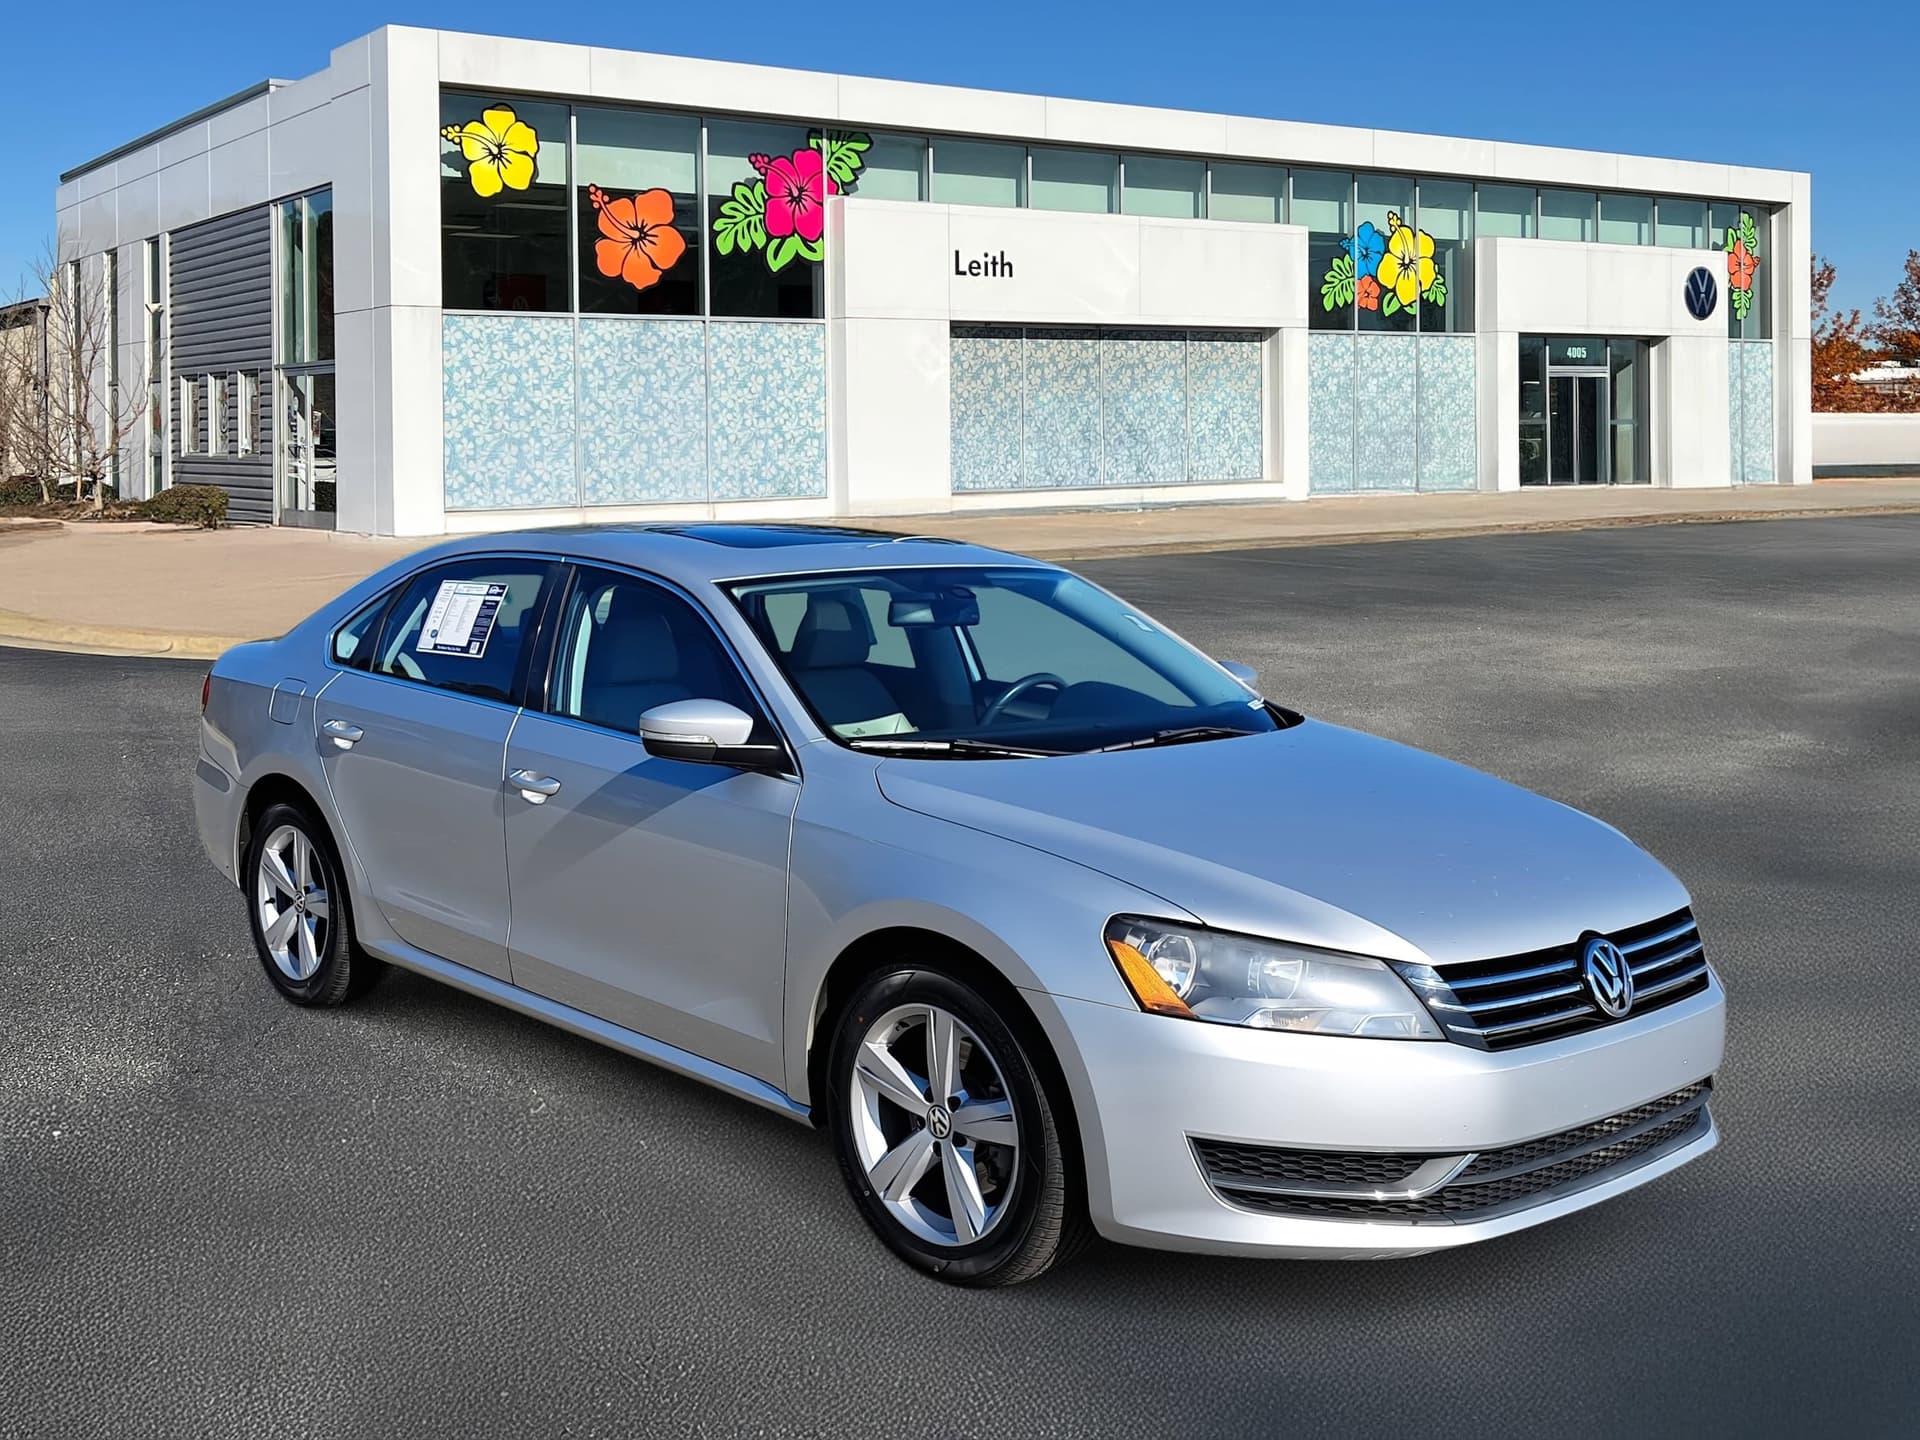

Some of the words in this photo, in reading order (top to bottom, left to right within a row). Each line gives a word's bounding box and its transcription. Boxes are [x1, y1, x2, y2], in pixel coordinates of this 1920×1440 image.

[954, 249, 1014, 278] Leith
[1686, 268, 1717, 317] VW
[1566, 346, 1588, 359] 4005
[1586, 939, 1632, 1015] VW
